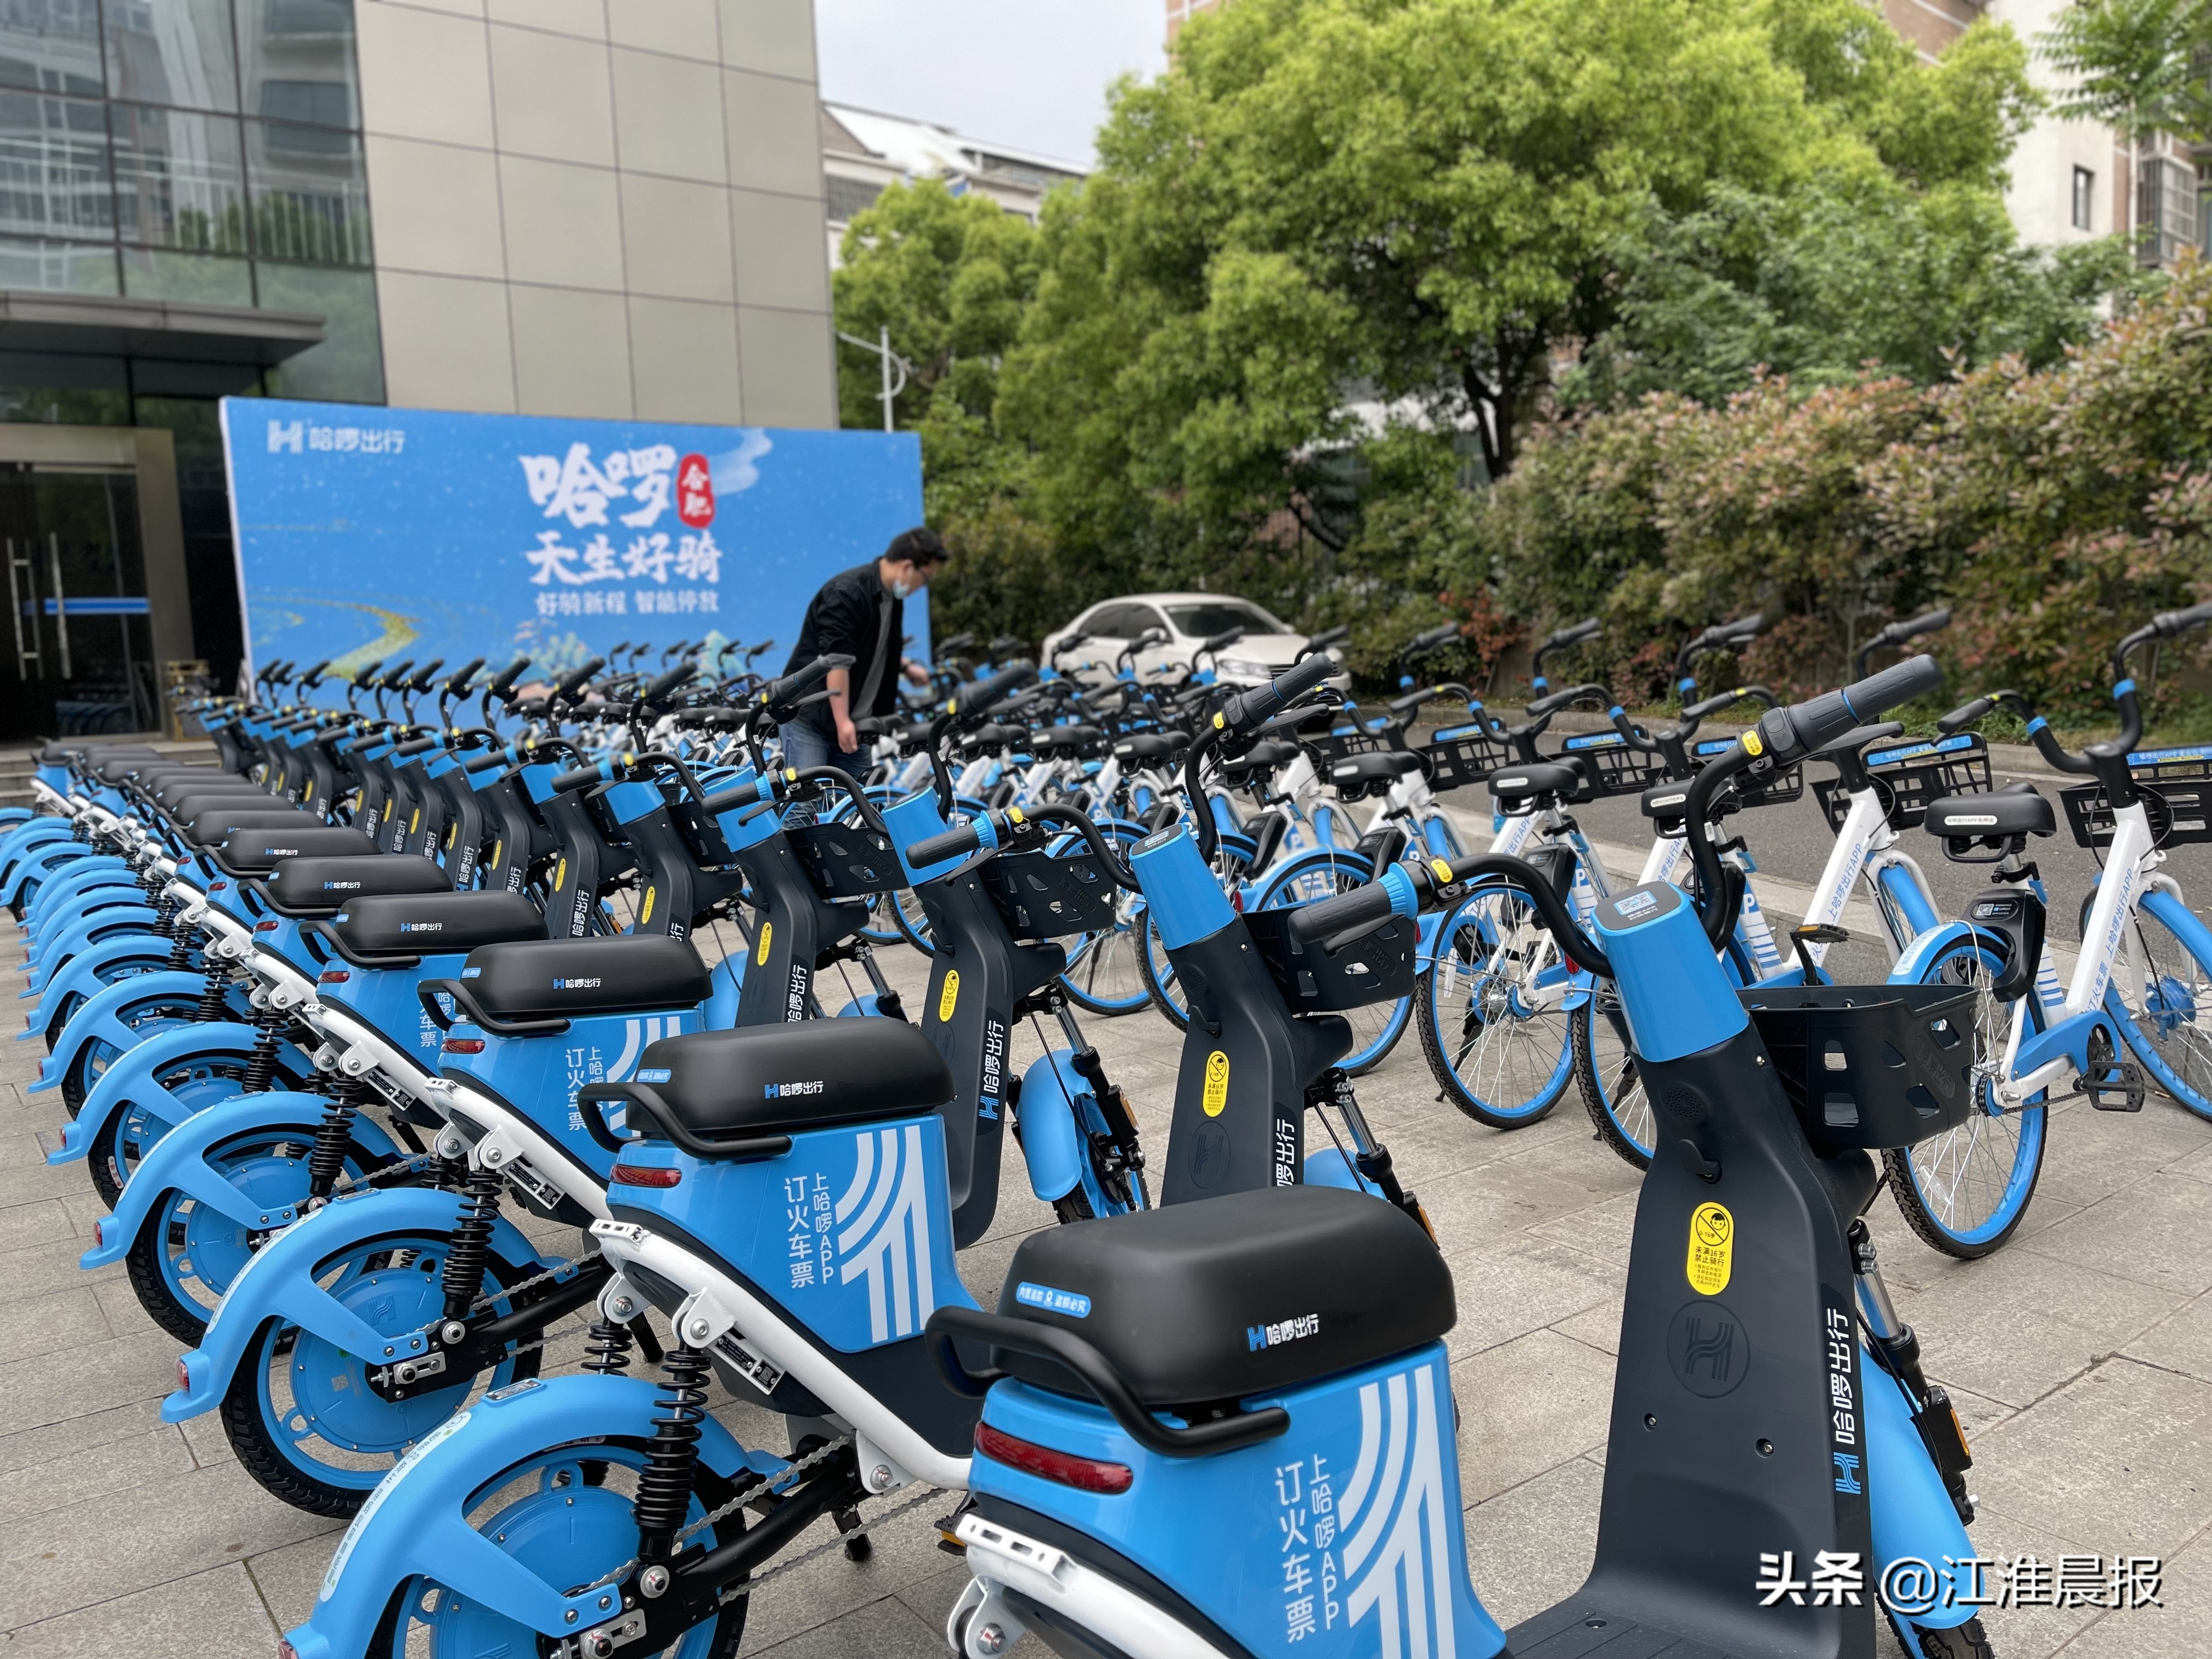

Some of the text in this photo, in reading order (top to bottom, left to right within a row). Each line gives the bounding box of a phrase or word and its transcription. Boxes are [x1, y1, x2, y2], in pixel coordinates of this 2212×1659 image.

[309, 427, 405, 454] 哈啰出行
[518, 442, 678, 528] 哈啰
[682, 463, 712, 517] 合肥
[525, 529, 723, 585] 天生好骑
[535, 590, 720, 616] 好骑新程 智能停放
[393, 819, 407, 852] 哈啰出行
[459, 845, 475, 883] 哈啰出行
[1828, 843, 1862, 922] 上哈啰出行APP
[411, 922, 443, 931] 哈啰出行
[572, 889, 590, 936] 哈啰出行
[2106, 868, 2134, 959] 上哈啰出行APP
[566, 978, 601, 988] 哈啰出行
[984, 1020, 1004, 1093] 哈啰出行
[780, 1081, 823, 1097] 哈啰出行
[784, 1176, 815, 1289] 订火车票
[812, 1172, 834, 1284] 上哈啰APP
[1695, 1246, 1725, 1258] 未满16岁
[1695, 1254, 1724, 1267] 禁止骑行
[1266, 1313, 1319, 1345] 哈啰出行
[1827, 1308, 1855, 1445] 哈啰出行
[1275, 1461, 1317, 1644] 订火车票
[1310, 1454, 1338, 1630] 上哈啰APP
